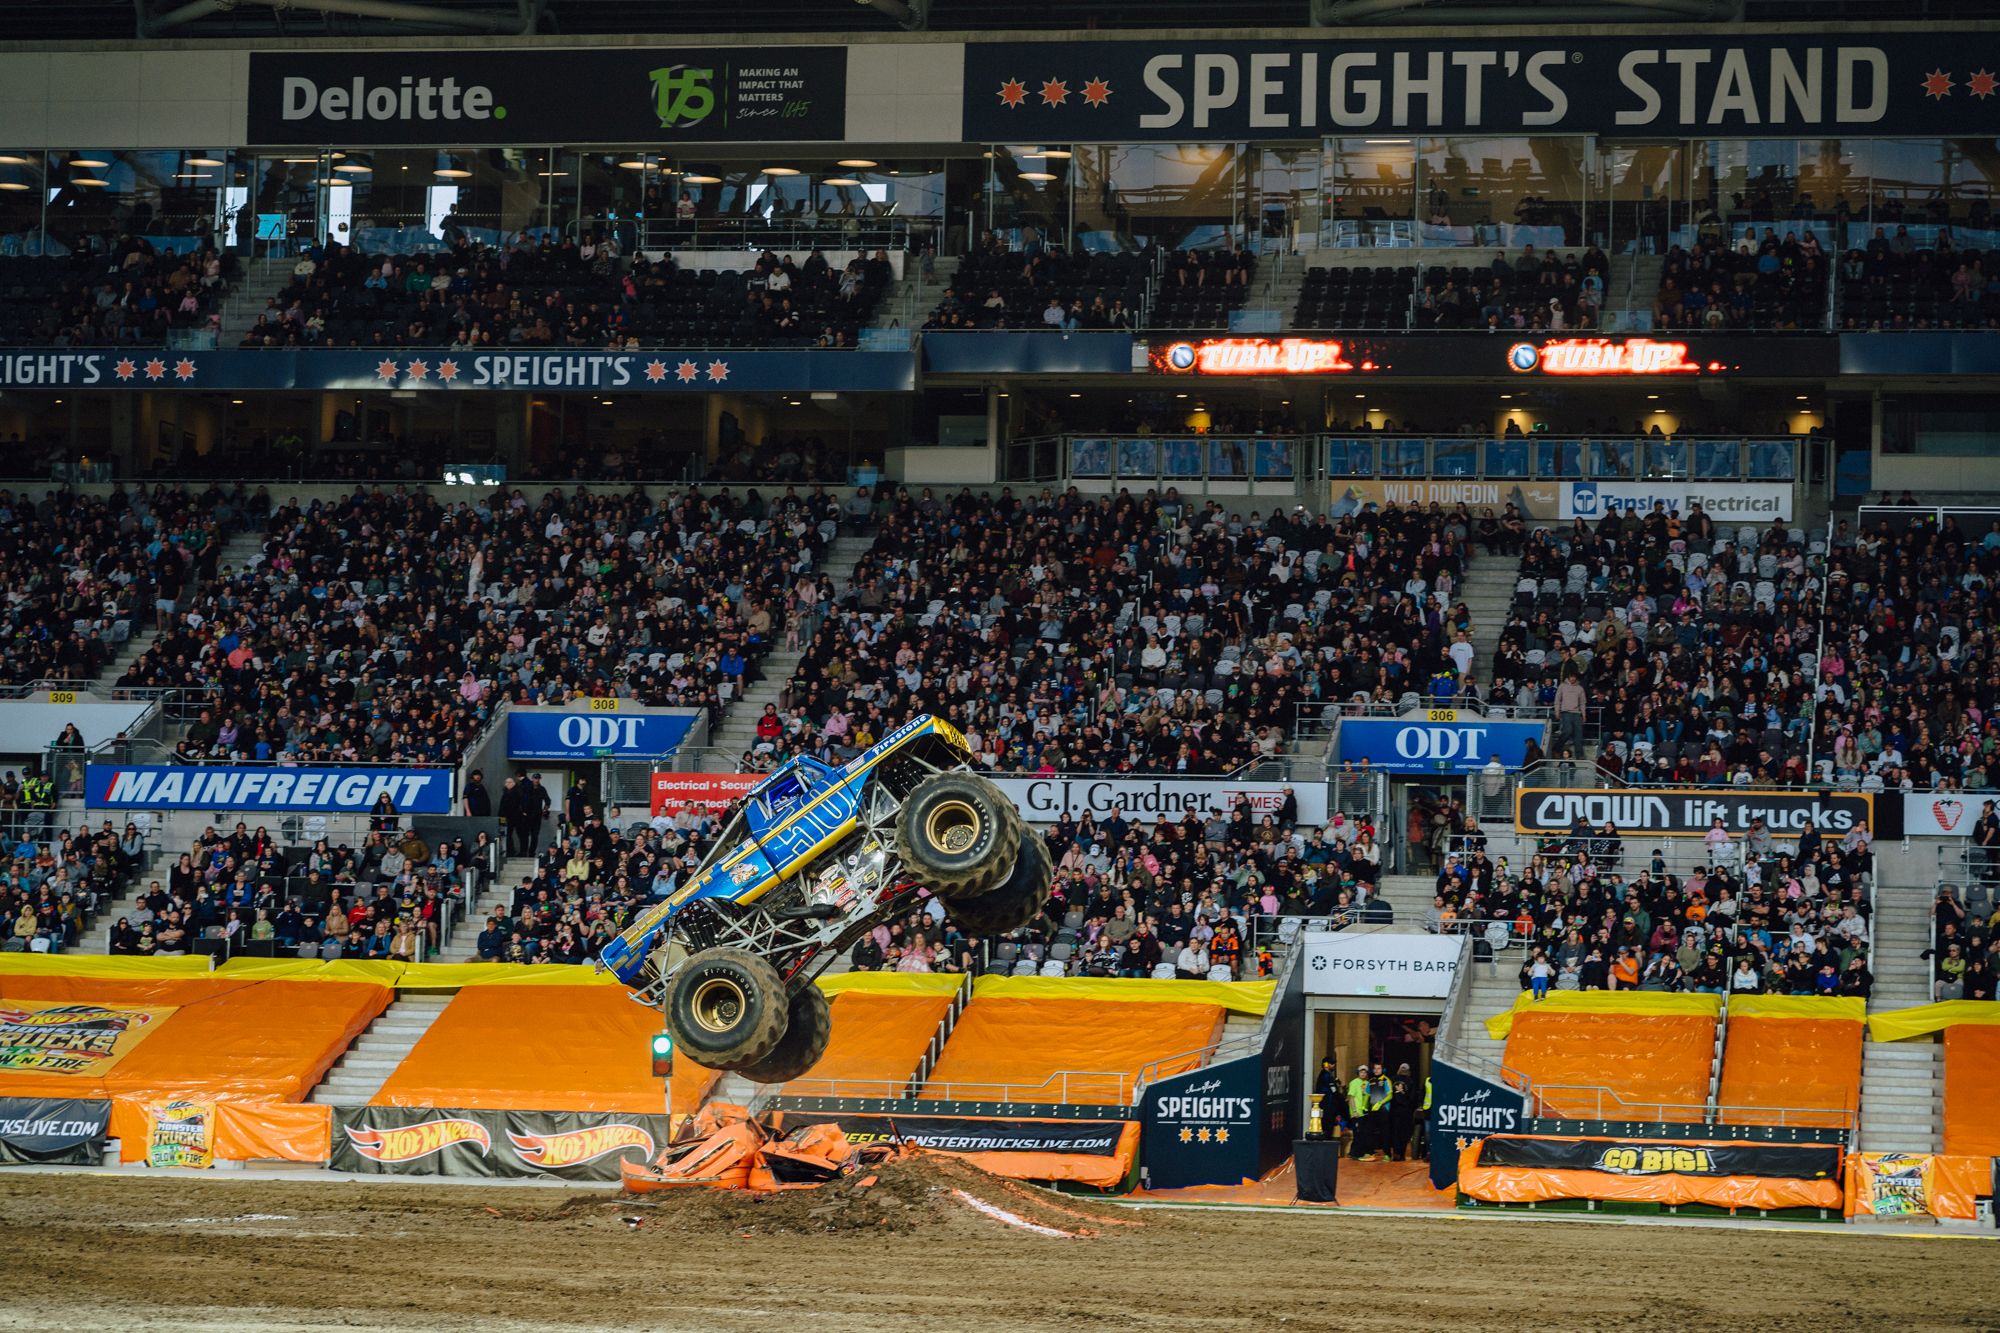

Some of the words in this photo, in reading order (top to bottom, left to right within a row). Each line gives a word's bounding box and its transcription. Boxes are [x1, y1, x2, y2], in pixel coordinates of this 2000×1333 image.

[739, 68, 781, 77] MAKING
[782, 68, 799, 76] AN
[738, 80, 776, 89] IMPACT
[778, 80, 804, 88] THAT
[1139, 50, 1567, 129] SPEIGHT'S
[1614, 47, 1890, 126] STAND
[282, 76, 507, 120] Deloitte.
[648, 66, 715, 128] 175
[738, 93, 784, 102] MATTERS
[736, 103, 779, 119] since
[1547, 345, 1625, 369] TURN
[0, 355, 101, 384] IGHT'S
[473, 356, 631, 386] SPEIGHT'S
[1383, 484, 1426, 504] WILD
[1428, 484, 1499, 504] DUNEDIN
[1685, 495, 1780, 512] Electrical
[51, 692, 74, 704] 309
[593, 699, 616, 711] 308
[1430, 710, 1454, 722] 306
[558, 715, 645, 748] ODT
[872, 715, 928, 757] Firestone
[1395, 726, 1488, 760] ODT
[109, 771, 432, 806] MAINFREIGHT
[657, 780, 710, 791] Electrical
[720, 780, 762, 791] Securit
[665, 797, 687, 809] Fire
[1228, 796, 1282, 809] HMES
[1684, 799, 1729, 828] lift
[1737, 801, 1853, 830] trucks
[1333, 958, 1408, 971] FORSYTH
[1413, 960, 1458, 973] BARR
[1156, 1096, 1252, 1119] SPEIGHT'S
[1437, 1104, 1516, 1130] SPEIGHT'S
[0, 1119, 100, 1137] KSLIVE.COM
[157, 1122, 205, 1133] MONSTER
[154, 1130, 205, 1147] TRUCKS
[1603, 1148, 1638, 1169] GO
[1641, 1149, 1709, 1172] BIG!
